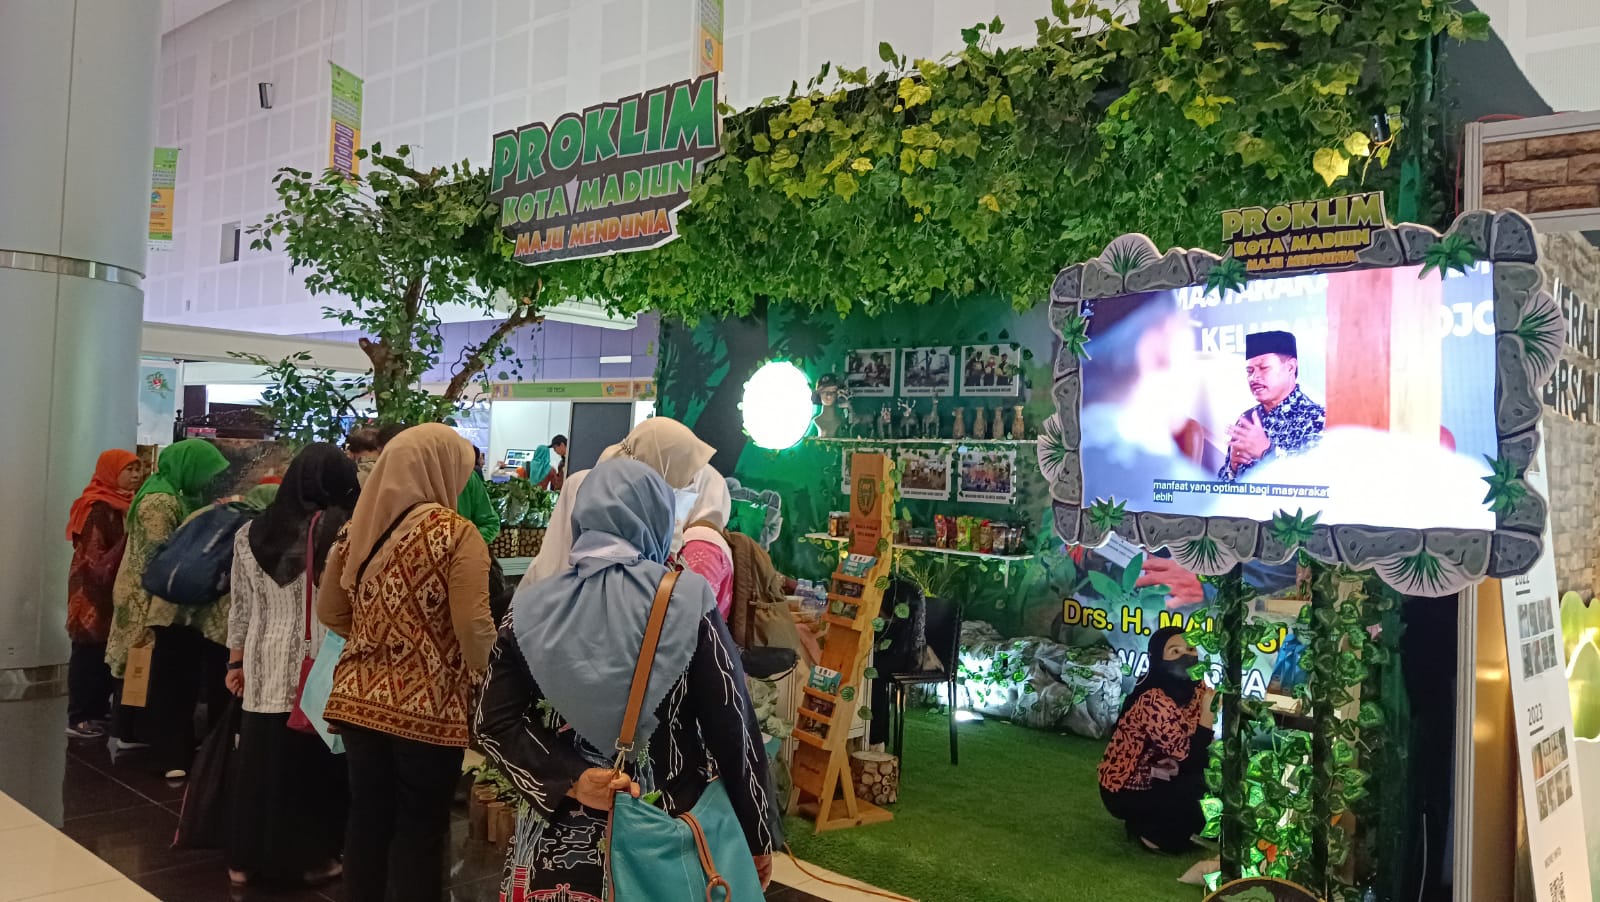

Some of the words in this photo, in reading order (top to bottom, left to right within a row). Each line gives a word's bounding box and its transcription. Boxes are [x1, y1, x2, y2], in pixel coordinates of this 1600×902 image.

[491, 77, 716, 193] PROKLIM
[502, 186, 568, 227] KOTA
[576, 157, 694, 215] MADIUN
[514, 226, 565, 257] MAJU
[568, 208, 671, 248] MENDUNIA
[1222, 193, 1384, 241] PROKLIM
[1233, 237, 1283, 256] KOTA
[1290, 228, 1370, 250] MADIUN
[1247, 256, 1284, 272] MAJU
[1286, 250, 1358, 267] MENDUNIA
[1154, 482, 1188, 491] manfaat
[1189, 484, 1211, 494] yang
[1213, 483, 1247, 495] optimal
[1249, 485, 1270, 496] bagi
[1154, 492, 1173, 502] lebih
[1063, 599, 1113, 630] Drs.
[1122, 607, 1151, 635] H.
[1527, 703, 1543, 726] 2023
